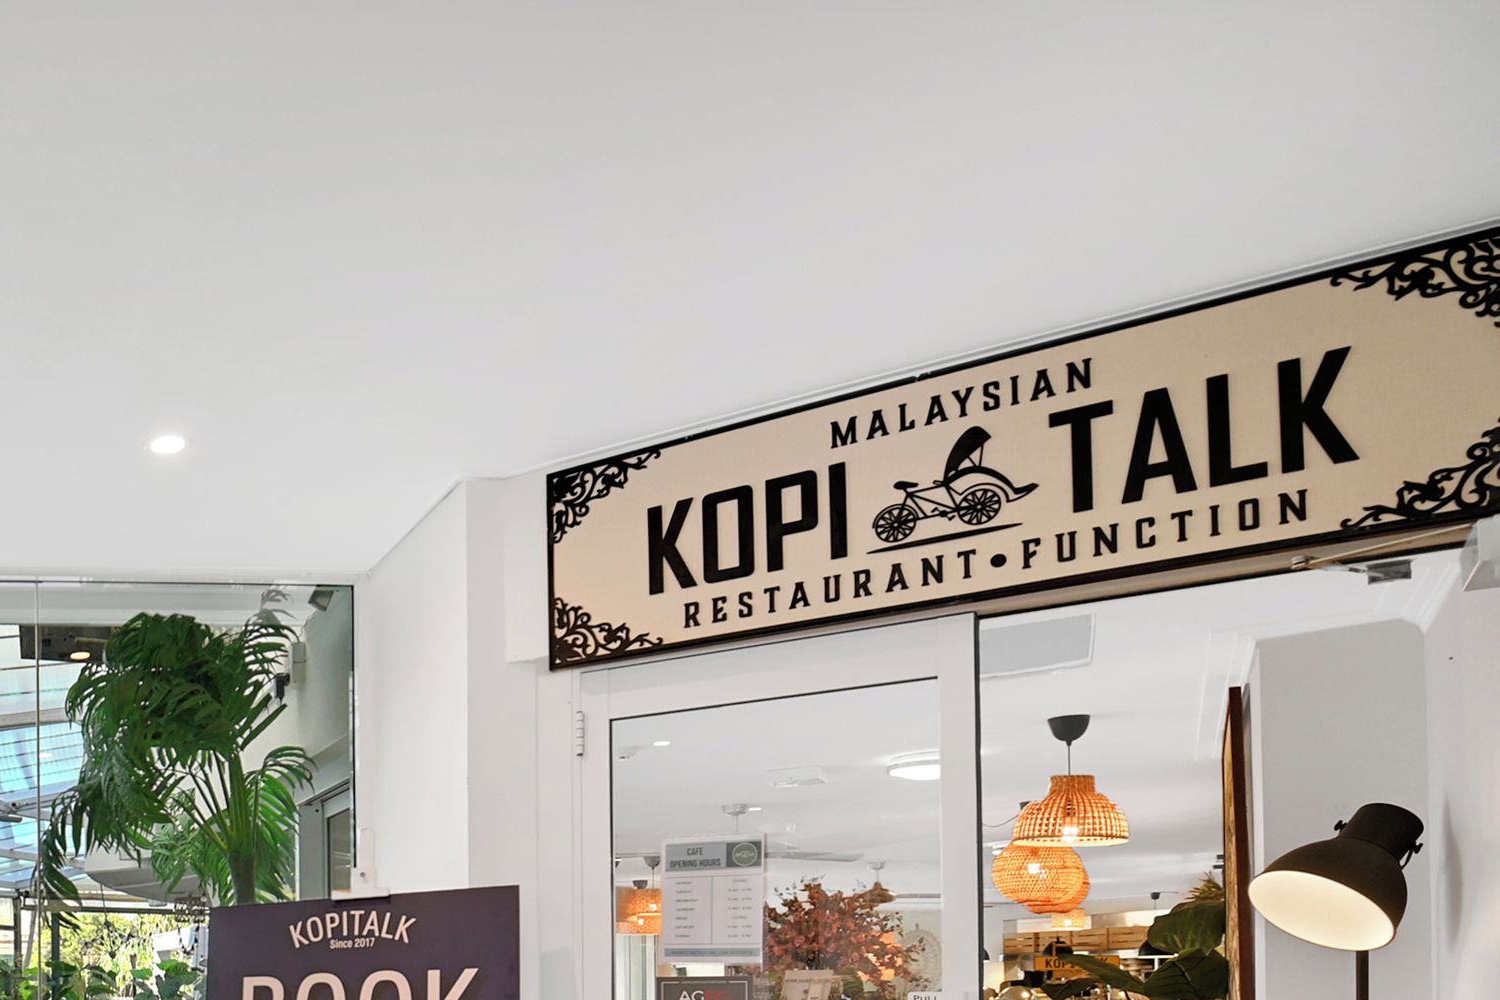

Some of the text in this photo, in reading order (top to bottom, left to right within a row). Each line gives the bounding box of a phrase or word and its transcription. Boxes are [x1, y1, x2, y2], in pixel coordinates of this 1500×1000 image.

[831, 358, 1097, 449] MALAYSIAN
[647, 345, 1361, 595] KOPI TALK
[670, 858, 721, 868] OPENING HOURS
[687, 847, 704, 856] CAFE
[288, 909, 417, 949] KOPITALK
[329, 937, 375, 949] Since 2017
